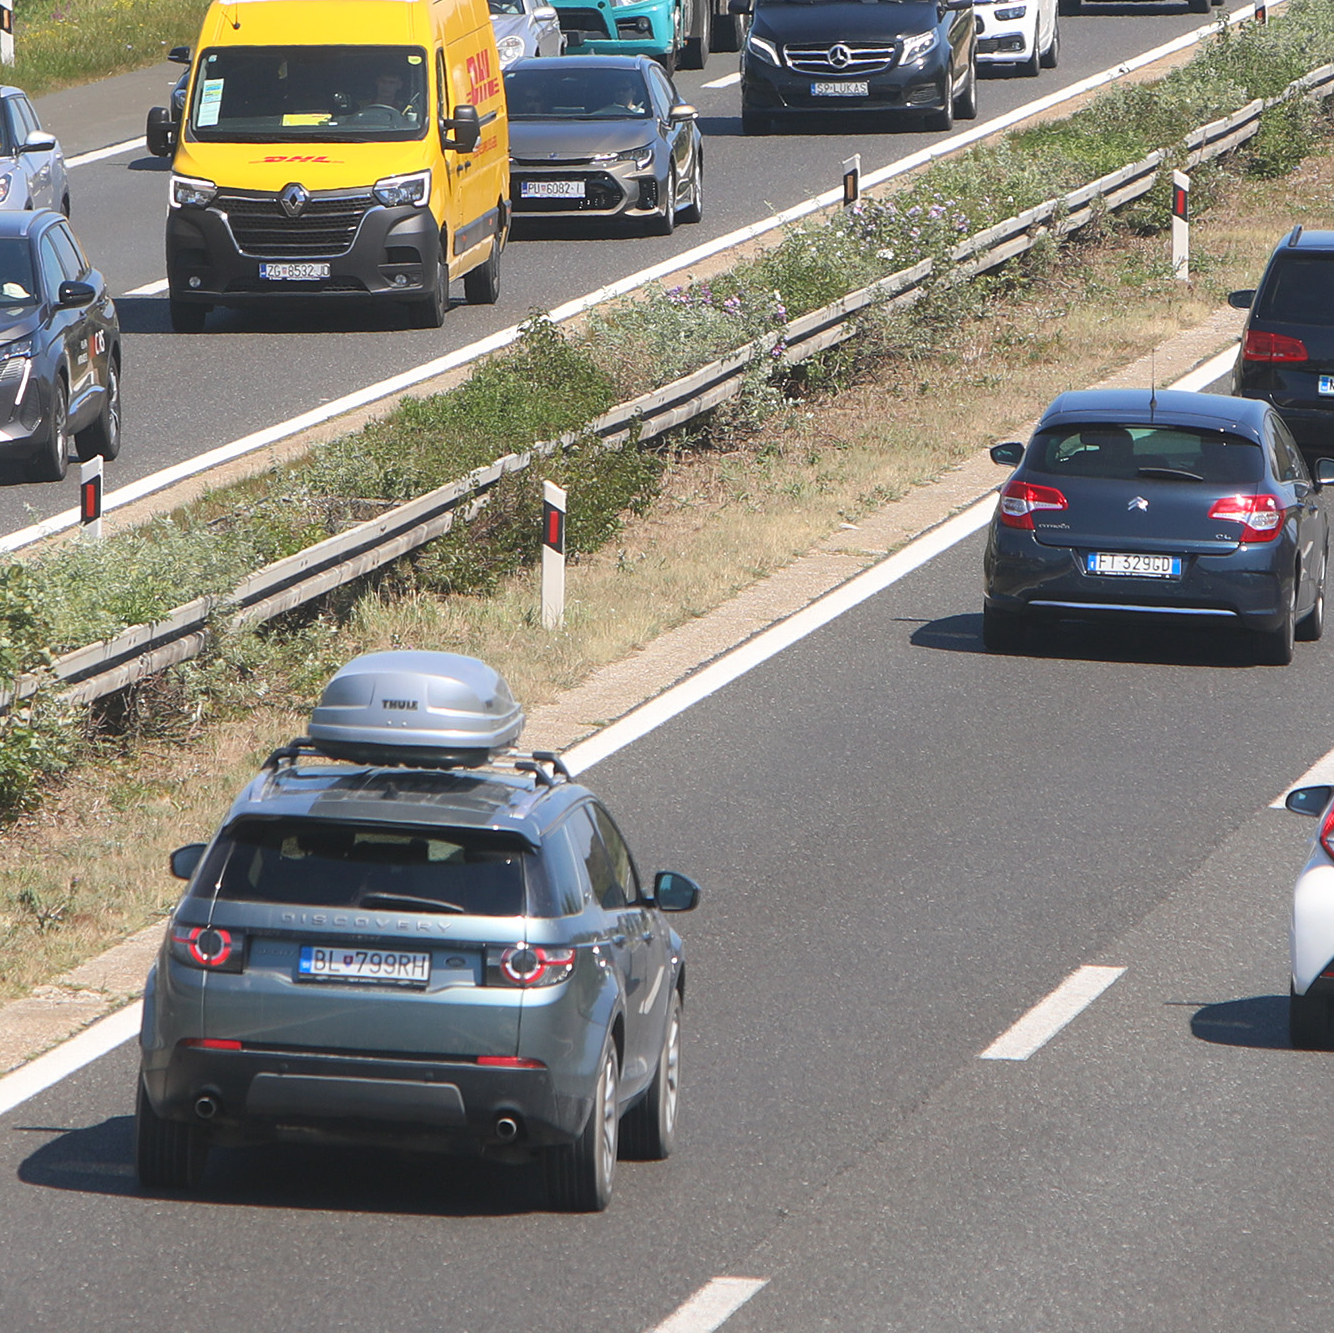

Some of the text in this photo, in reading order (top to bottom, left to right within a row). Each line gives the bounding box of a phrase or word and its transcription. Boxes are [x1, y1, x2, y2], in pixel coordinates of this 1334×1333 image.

[264, 155, 332, 164] DHL
[267, 265, 281, 277] ZG
[1098, 553, 1171, 572] FT 329GD
[382, 699, 418, 711] THULE
[280, 912, 452, 933] DISCOVERY
[313, 949, 427, 977] BL 799RH
